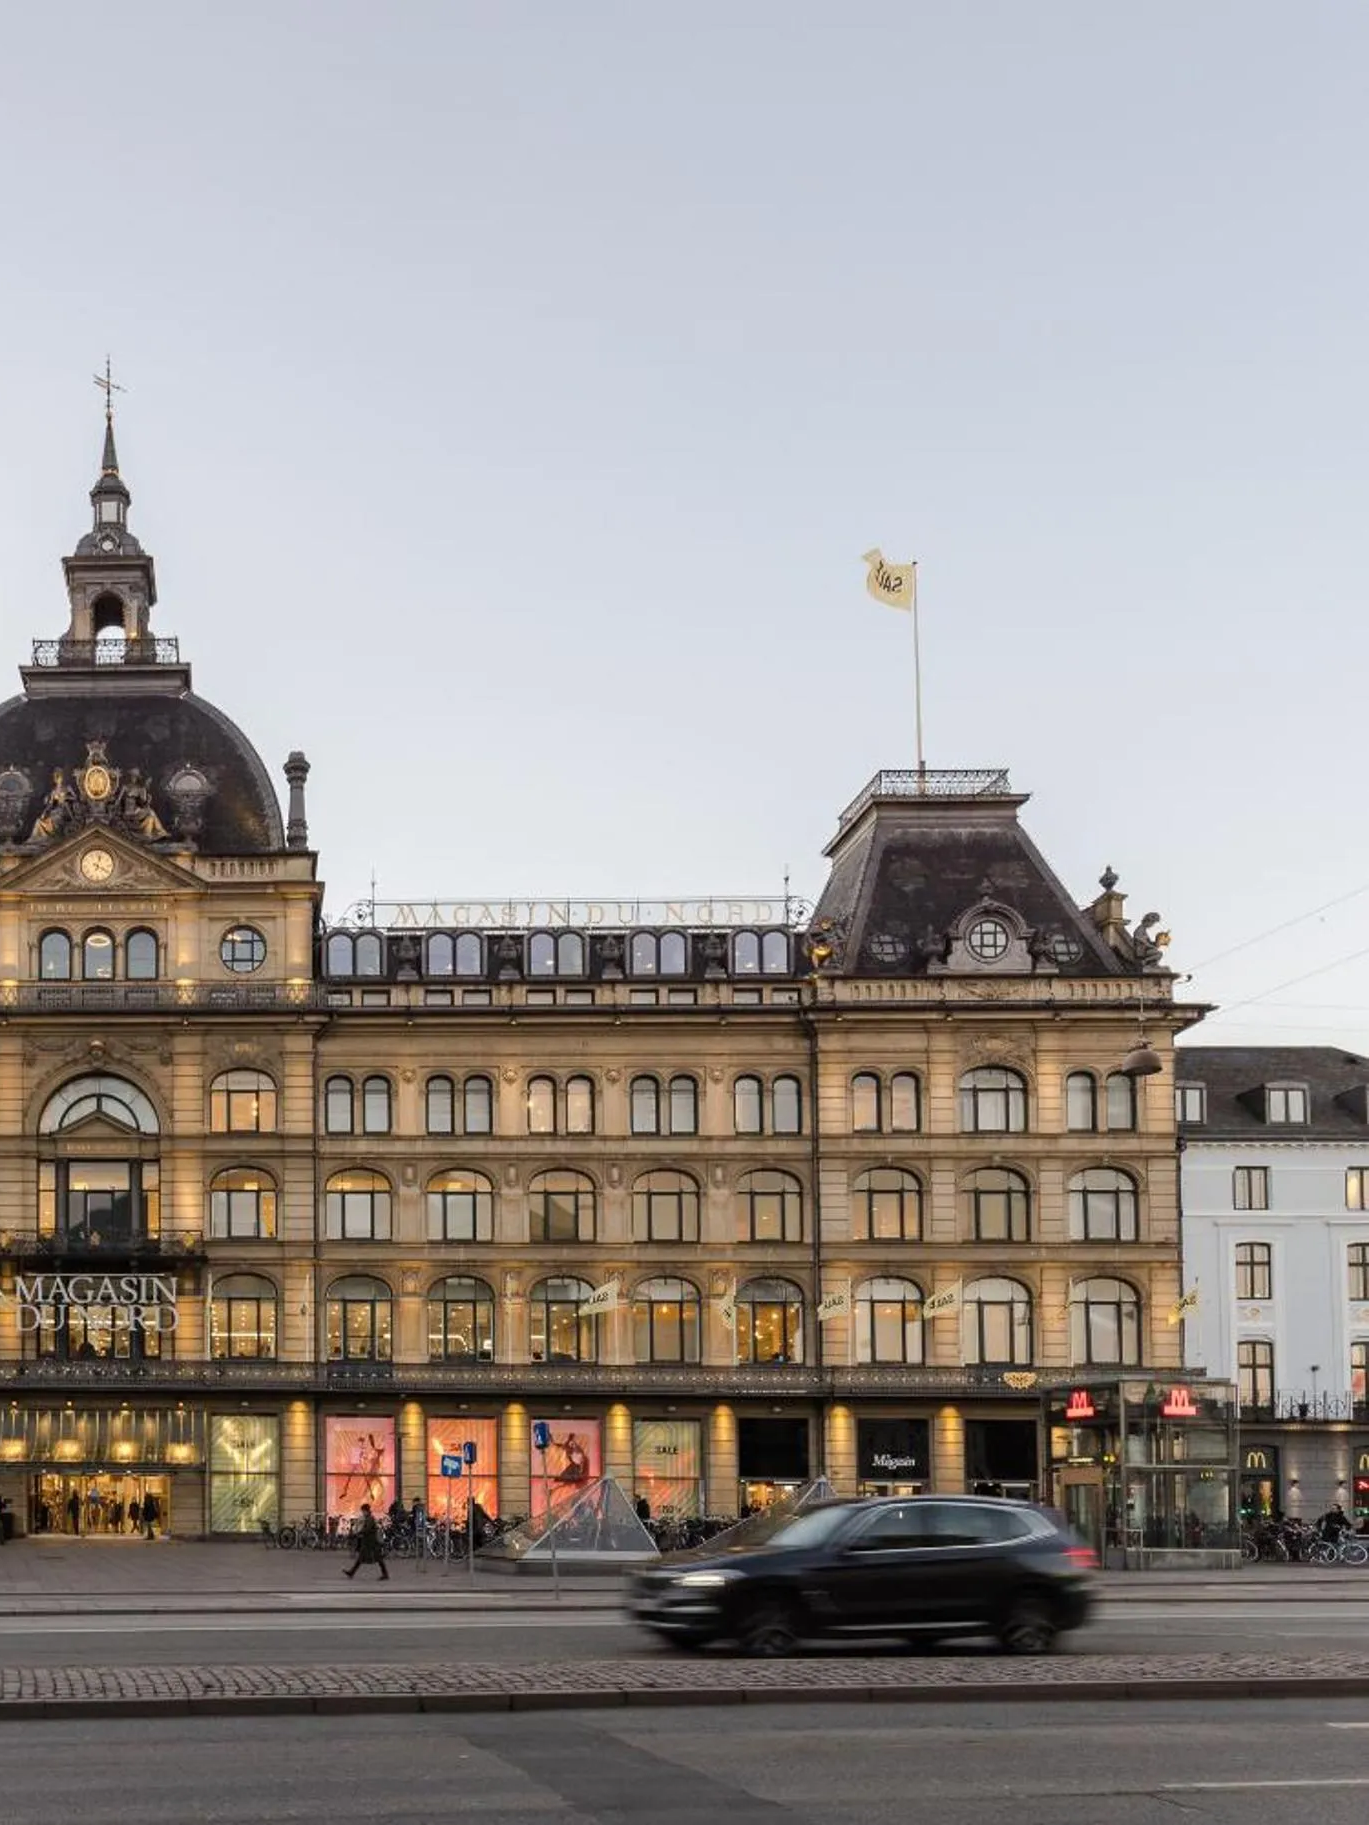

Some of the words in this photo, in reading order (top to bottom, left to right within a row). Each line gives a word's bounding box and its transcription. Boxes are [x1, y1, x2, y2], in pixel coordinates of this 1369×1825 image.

[391, 903, 568, 926] MAGASIN
[584, 902, 635, 925] DU
[663, 901, 773, 924] NORD
[15, 1276, 178, 1304] MAGASIN
[16, 1304, 68, 1331] DU
[74, 1304, 179, 1331] NORD
